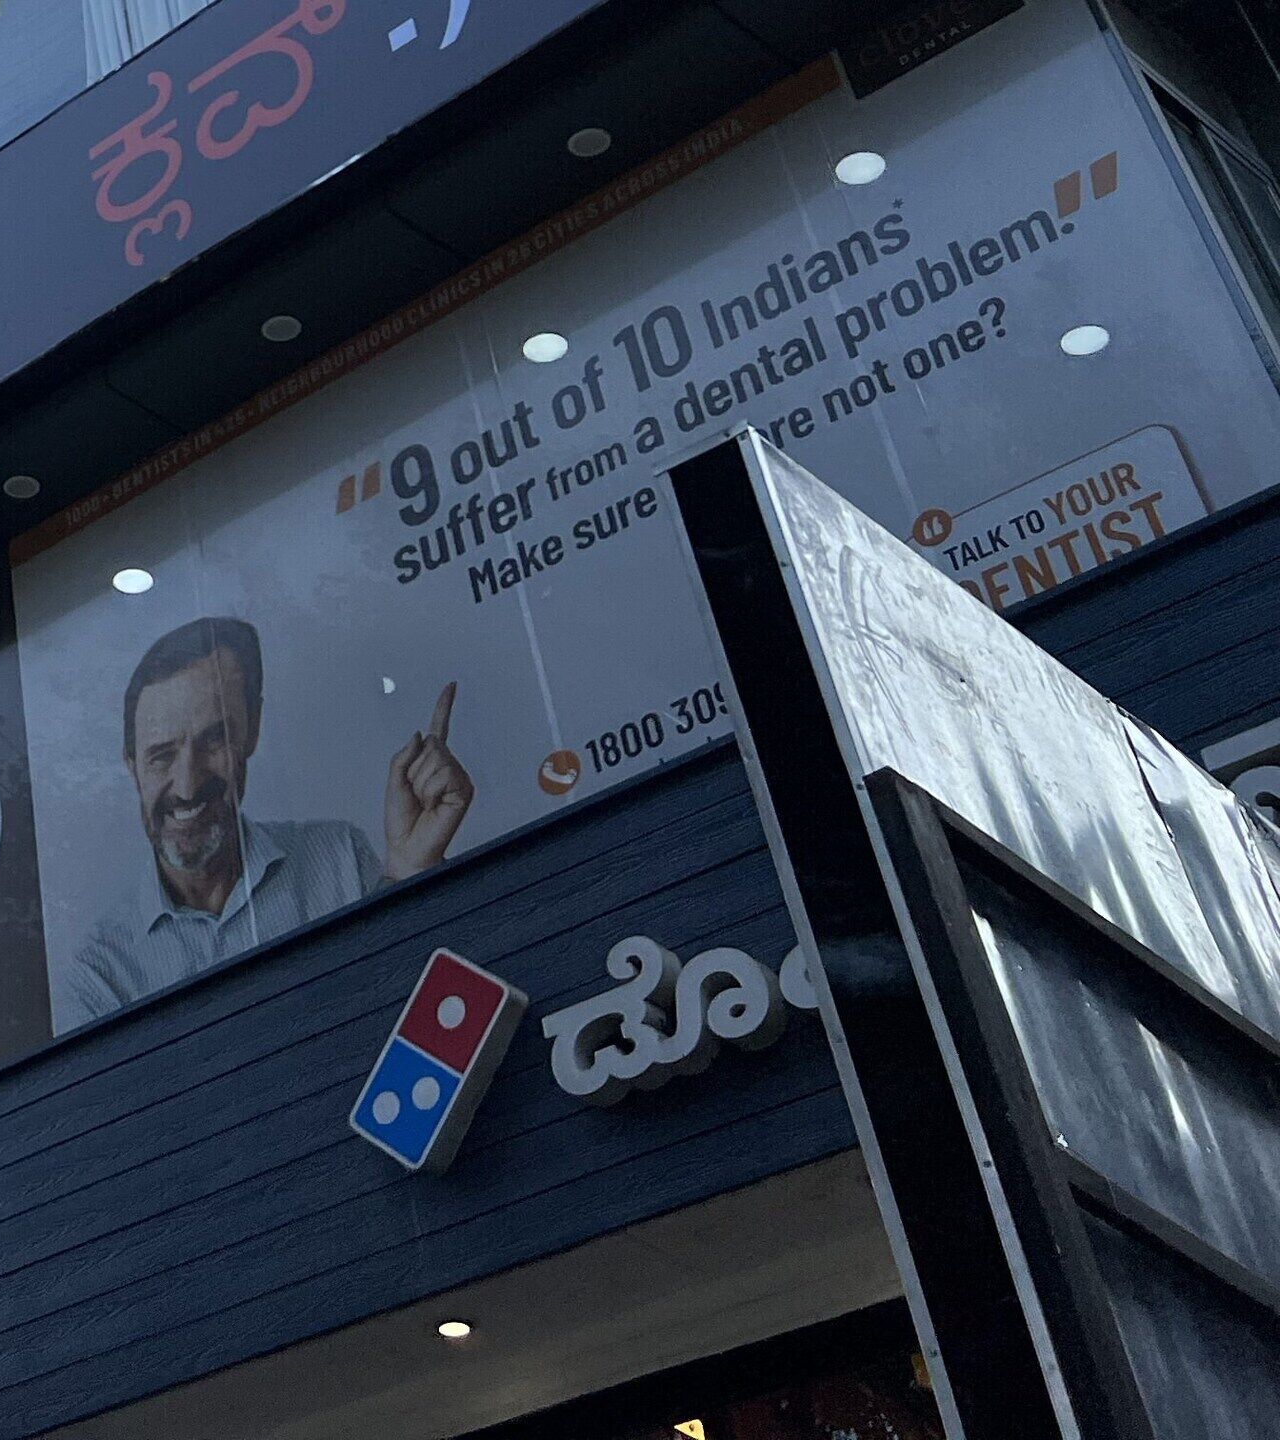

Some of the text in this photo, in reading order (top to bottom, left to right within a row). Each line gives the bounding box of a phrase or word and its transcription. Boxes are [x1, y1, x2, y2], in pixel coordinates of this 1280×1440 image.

[393, 478, 536, 585] suffer
[545, 442, 628, 502] from
[633, 416, 665, 454] a
[674, 317, 827, 433] dental
[450, 401, 540, 485] out
[552, 355, 606, 430] of
[613, 305, 693, 392] 10
[468, 534, 565, 604] Make
[573, 487, 659, 551] sure
[822, 359, 896, 422] not
[903, 297, 1006, 382] one?
[943, 462, 1141, 571] TALK TO YOUR
[585, 712, 665, 773] 1800
